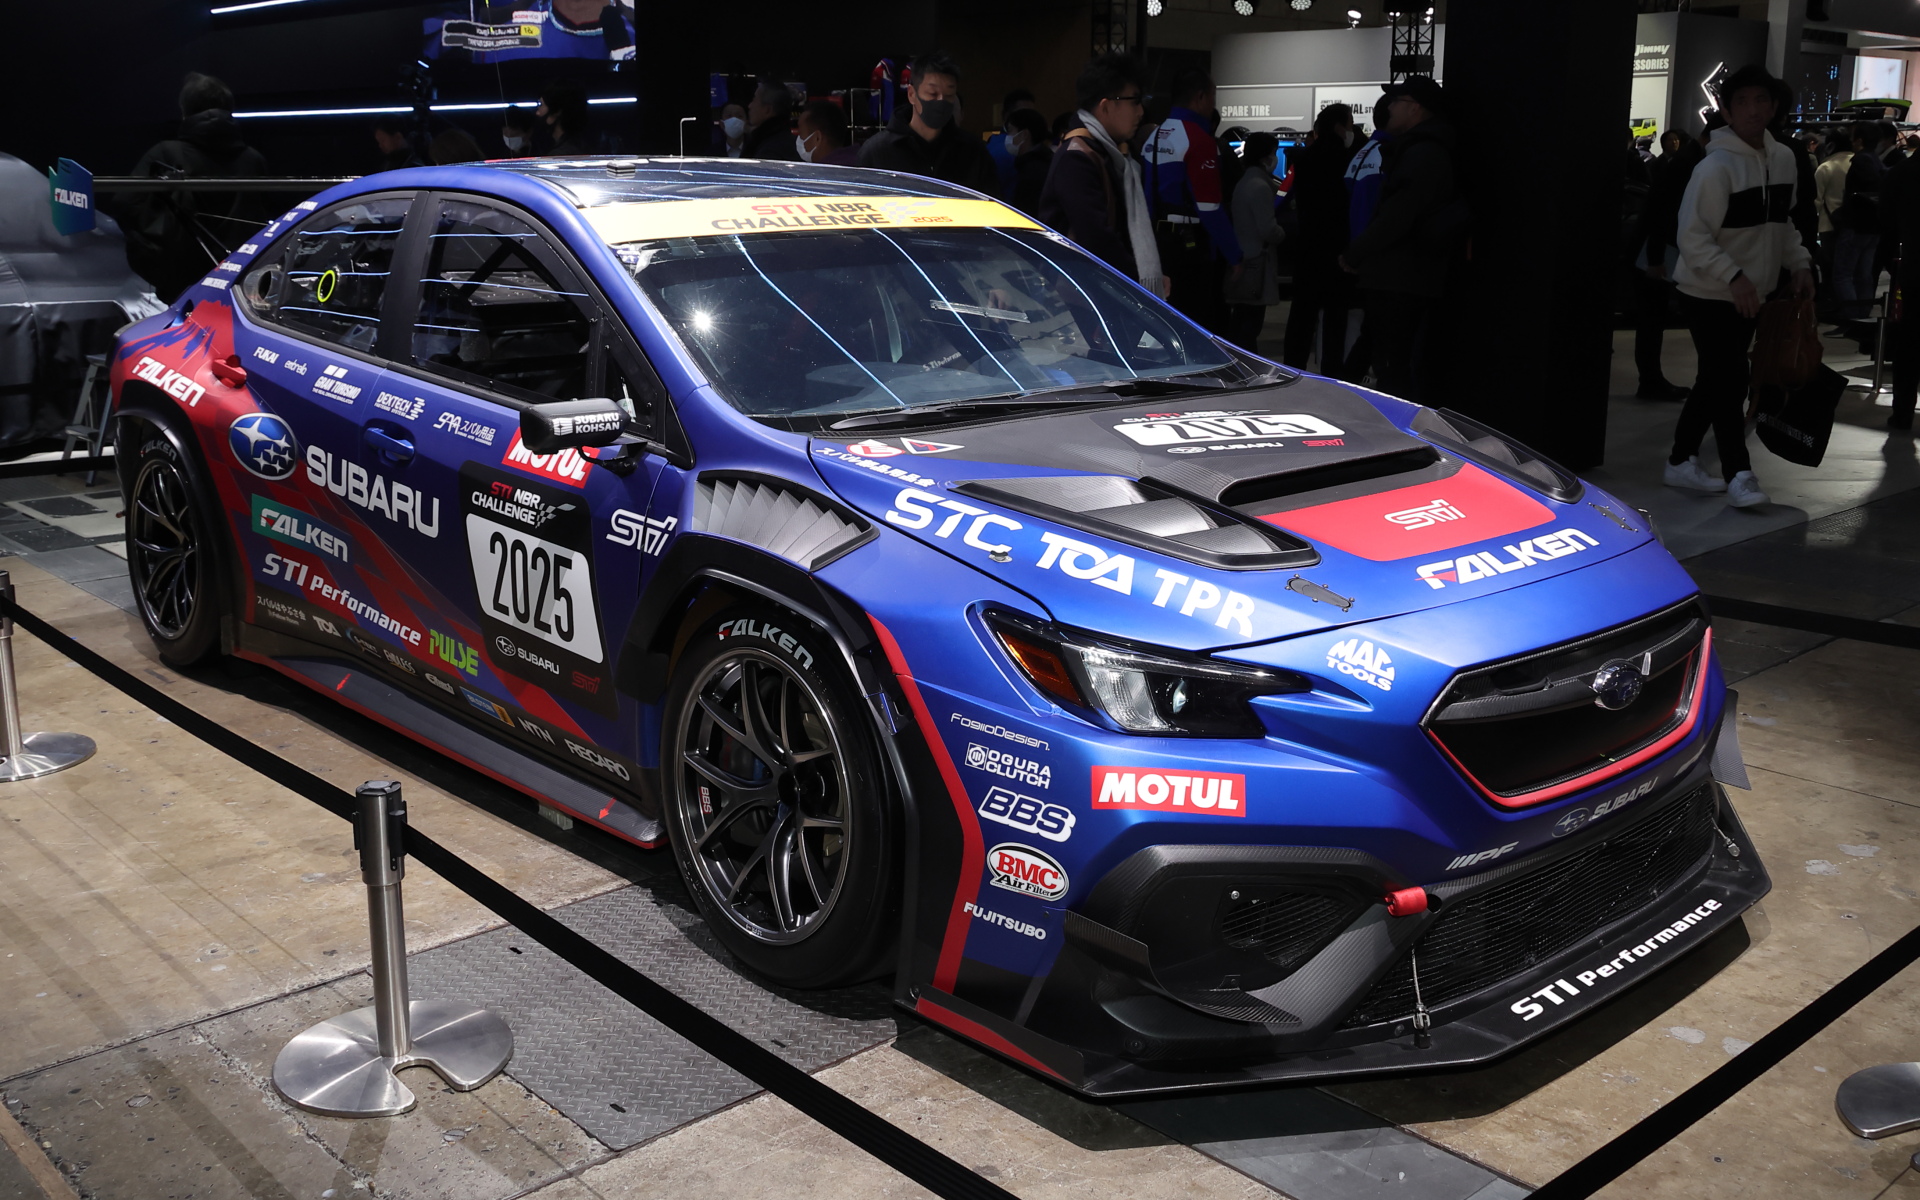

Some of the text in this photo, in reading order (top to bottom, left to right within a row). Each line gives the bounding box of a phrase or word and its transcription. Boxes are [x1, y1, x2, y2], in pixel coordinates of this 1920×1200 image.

[1221, 104, 1270, 117] SPARE TIRE
[54, 187, 88, 210] FALKEN
[751, 202, 877, 215] STI NBR
[711, 213, 890, 230] CHALLENGE
[253, 346, 280, 364] FUKAI
[132, 356, 206, 407] FALKEN
[314, 375, 362, 399] GRAN TURISMO
[377, 391, 412, 412] DEXTECH
[574, 412, 620, 425] SUBARU
[575, 421, 620, 434] KOHSAN
[1142, 416, 1318, 440] 2025
[140, 439, 177, 462] FALKEN
[1208, 441, 1284, 451] SUBARU
[306, 444, 439, 539] SUBARU
[490, 481, 541, 510] STI NBR
[471, 491, 537, 526] CHALLENGE
[260, 508, 348, 562] FALKEN
[885, 487, 1256, 638] STC TOA TPR
[1415, 528, 1600, 590] FALKEN
[262, 553, 422, 646] STI Performance
[489, 531, 575, 643] 2025
[429, 628, 479, 677] PULSE
[716, 619, 814, 670] FALKEN
[1327, 638, 1395, 681] MAC
[517, 647, 559, 675] SUBARU
[1325, 656, 1392, 692] TOOLS
[517, 716, 555, 745] NTN
[564, 738, 630, 781] RECARO
[985, 761, 1050, 789] CLUTCH
[987, 749, 1051, 778] OGURA
[700, 786, 713, 813] BBS
[1098, 772, 1239, 810] MOTUL
[1588, 776, 1659, 822] SUBARU
[978, 786, 1076, 842] BBS
[995, 874, 1051, 897] Air Filter
[996, 851, 1059, 890] BMC
[963, 901, 1046, 940] FUJITSUBO
[1510, 897, 1723, 1022] STI Performance
